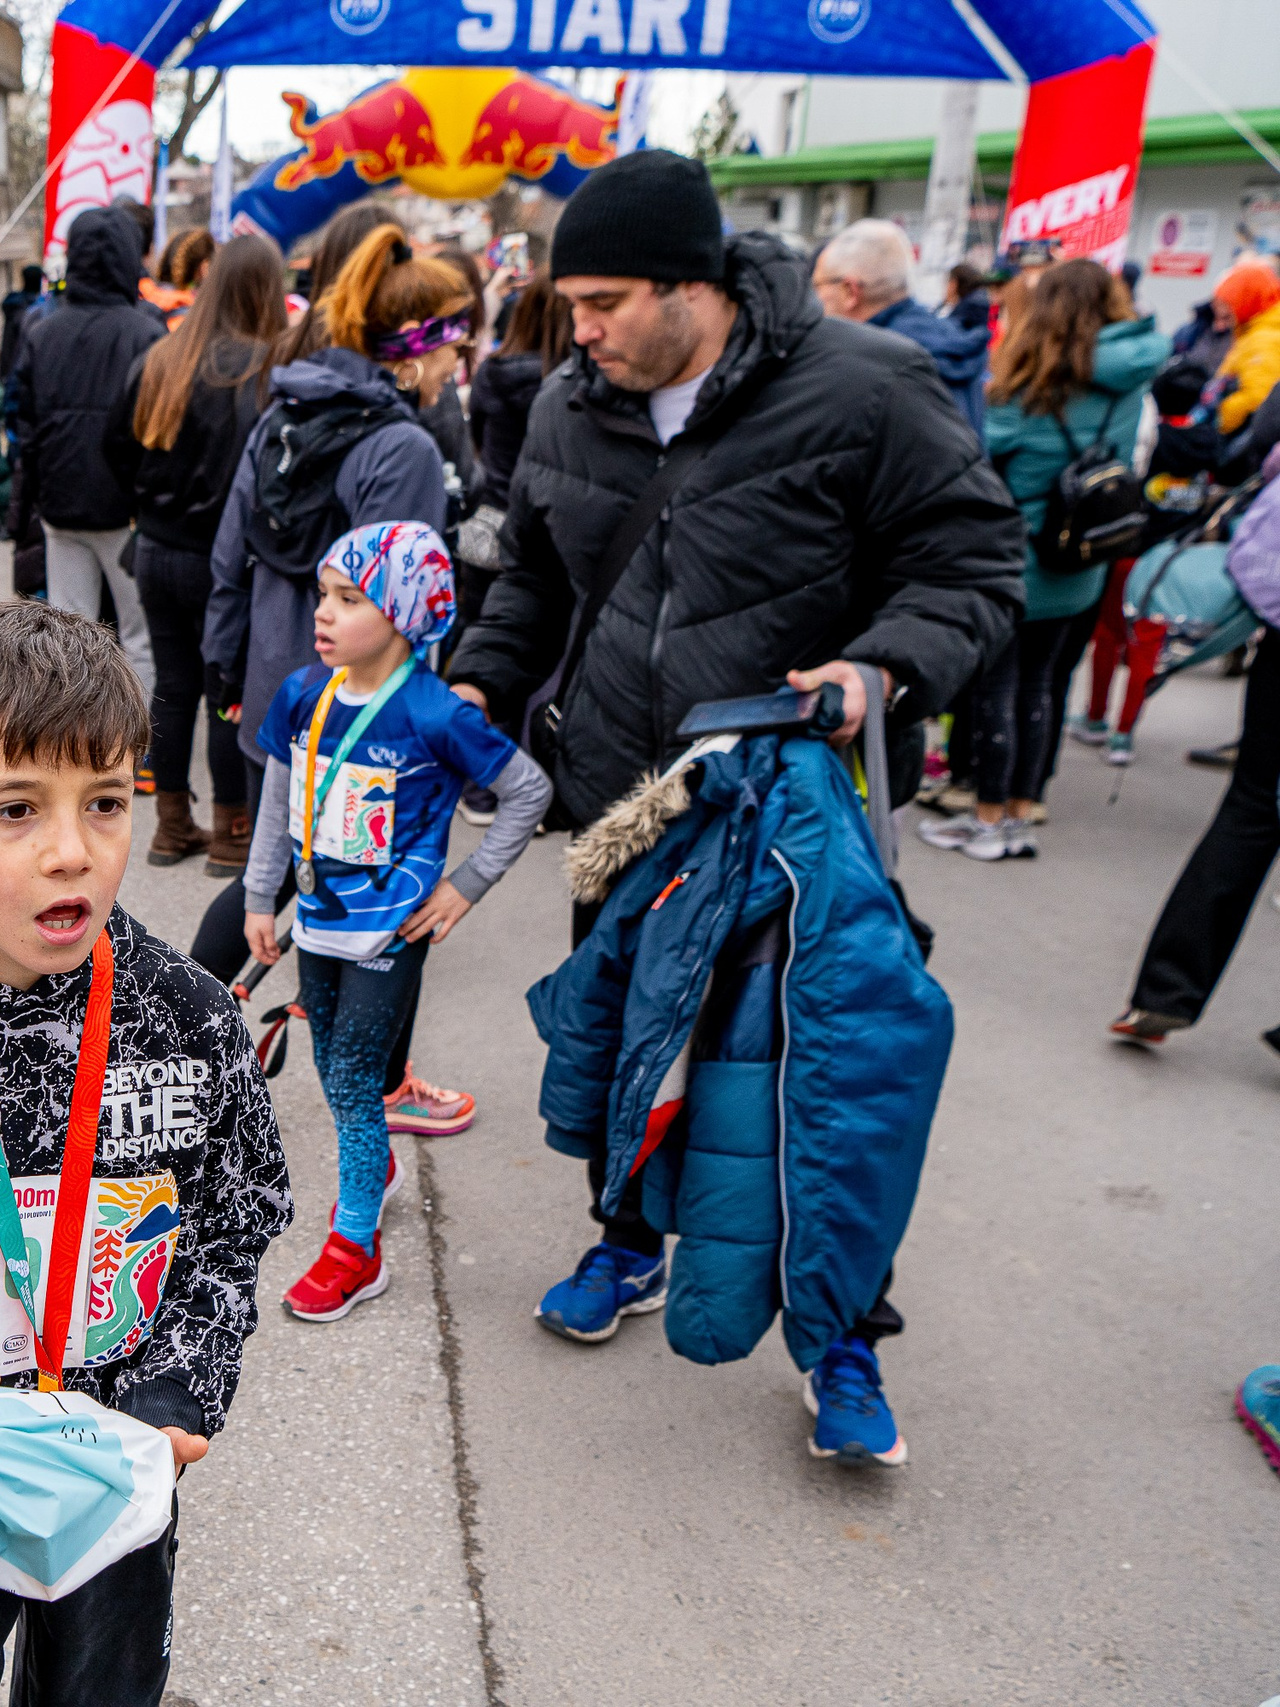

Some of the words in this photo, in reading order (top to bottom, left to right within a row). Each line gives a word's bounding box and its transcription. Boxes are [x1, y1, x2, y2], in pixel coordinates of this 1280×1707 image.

[101, 1059, 209, 1094] BEYOND
[100, 1085, 195, 1138] THE
[102, 1121, 208, 1161] DISTANCE
